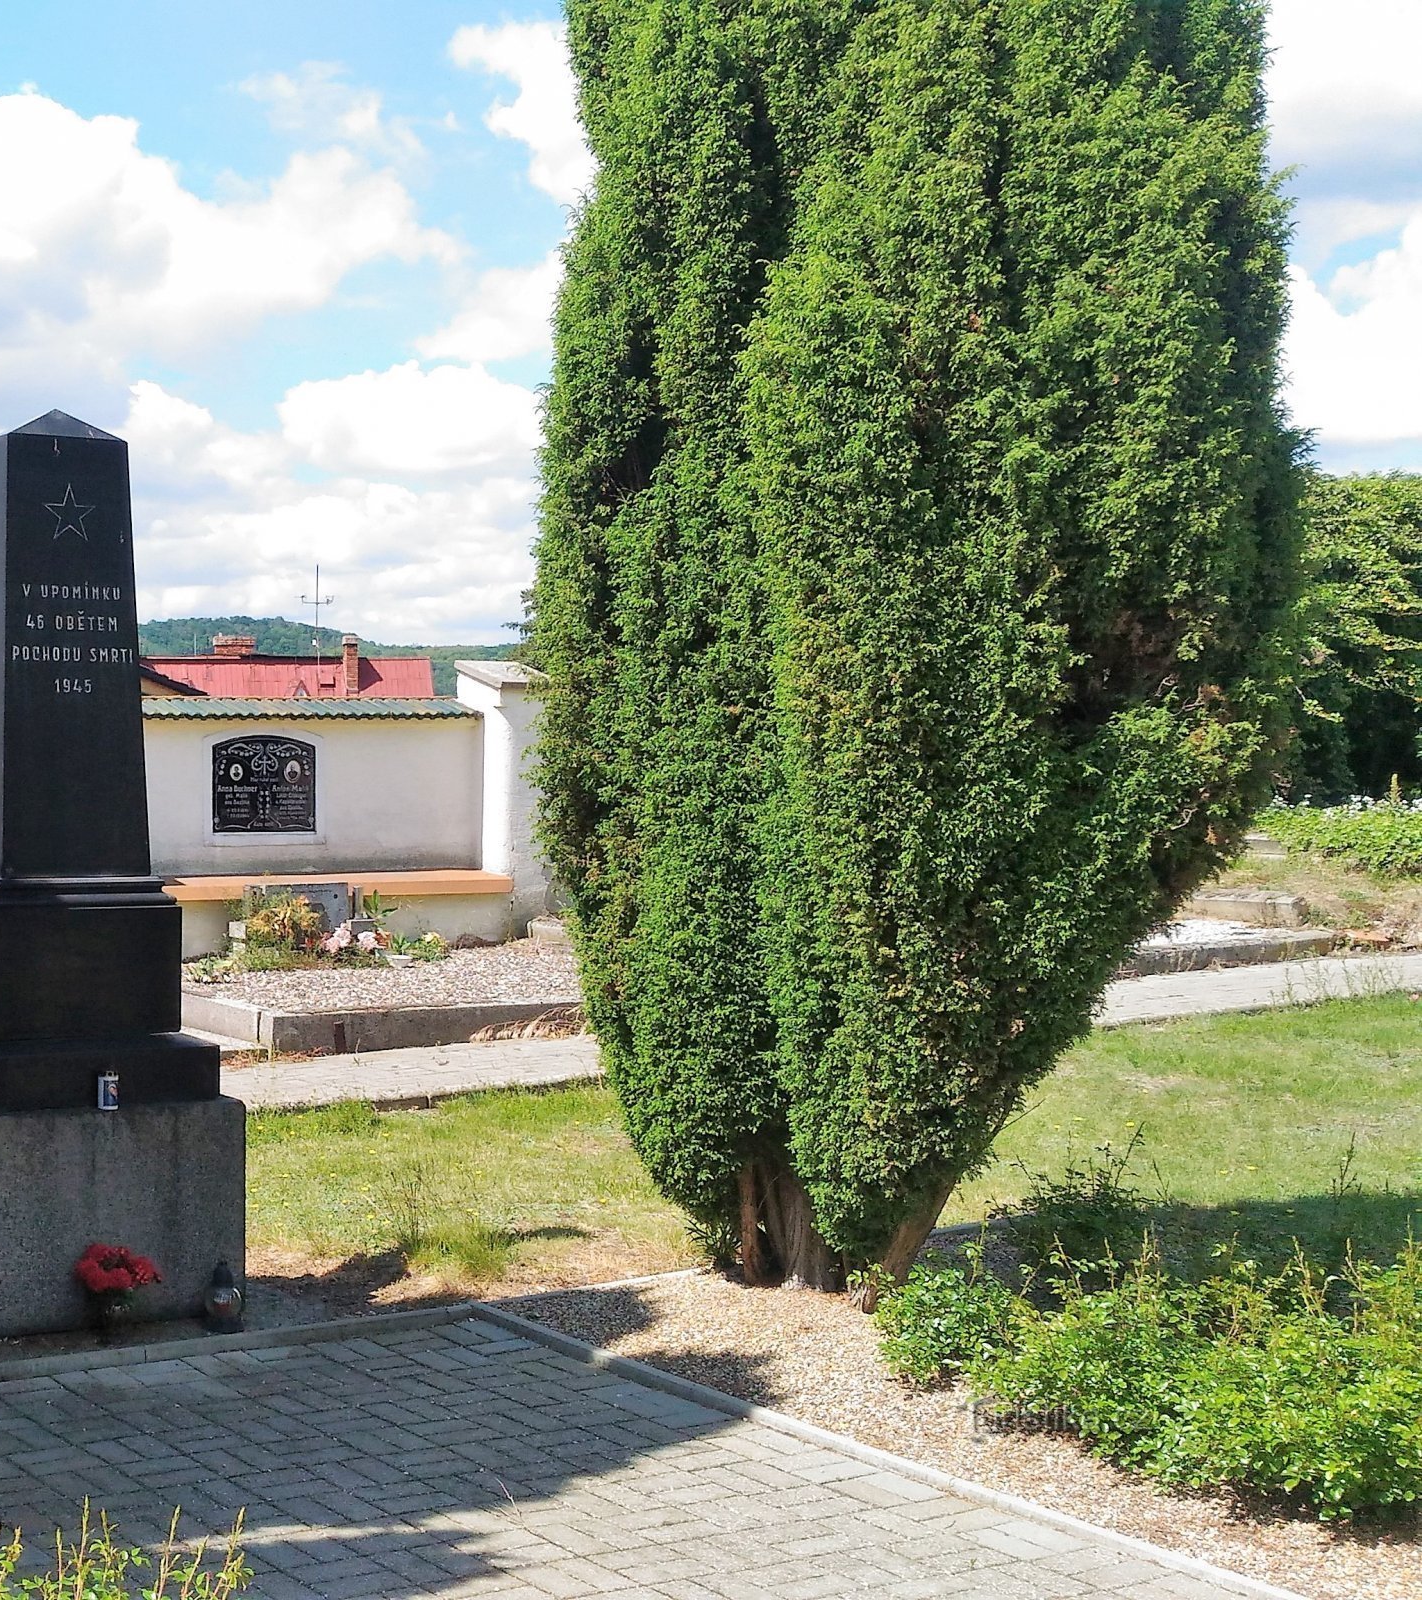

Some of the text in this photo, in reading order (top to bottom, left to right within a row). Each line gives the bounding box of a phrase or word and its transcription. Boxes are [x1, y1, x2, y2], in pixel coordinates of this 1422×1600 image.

[22, 581, 121, 600] V UPOMÍNKU
[26, 610, 119, 632] 46 OBĚTEM
[12, 645, 134, 664] POCHODU SMRTI
[54, 678, 92, 693] 1945
